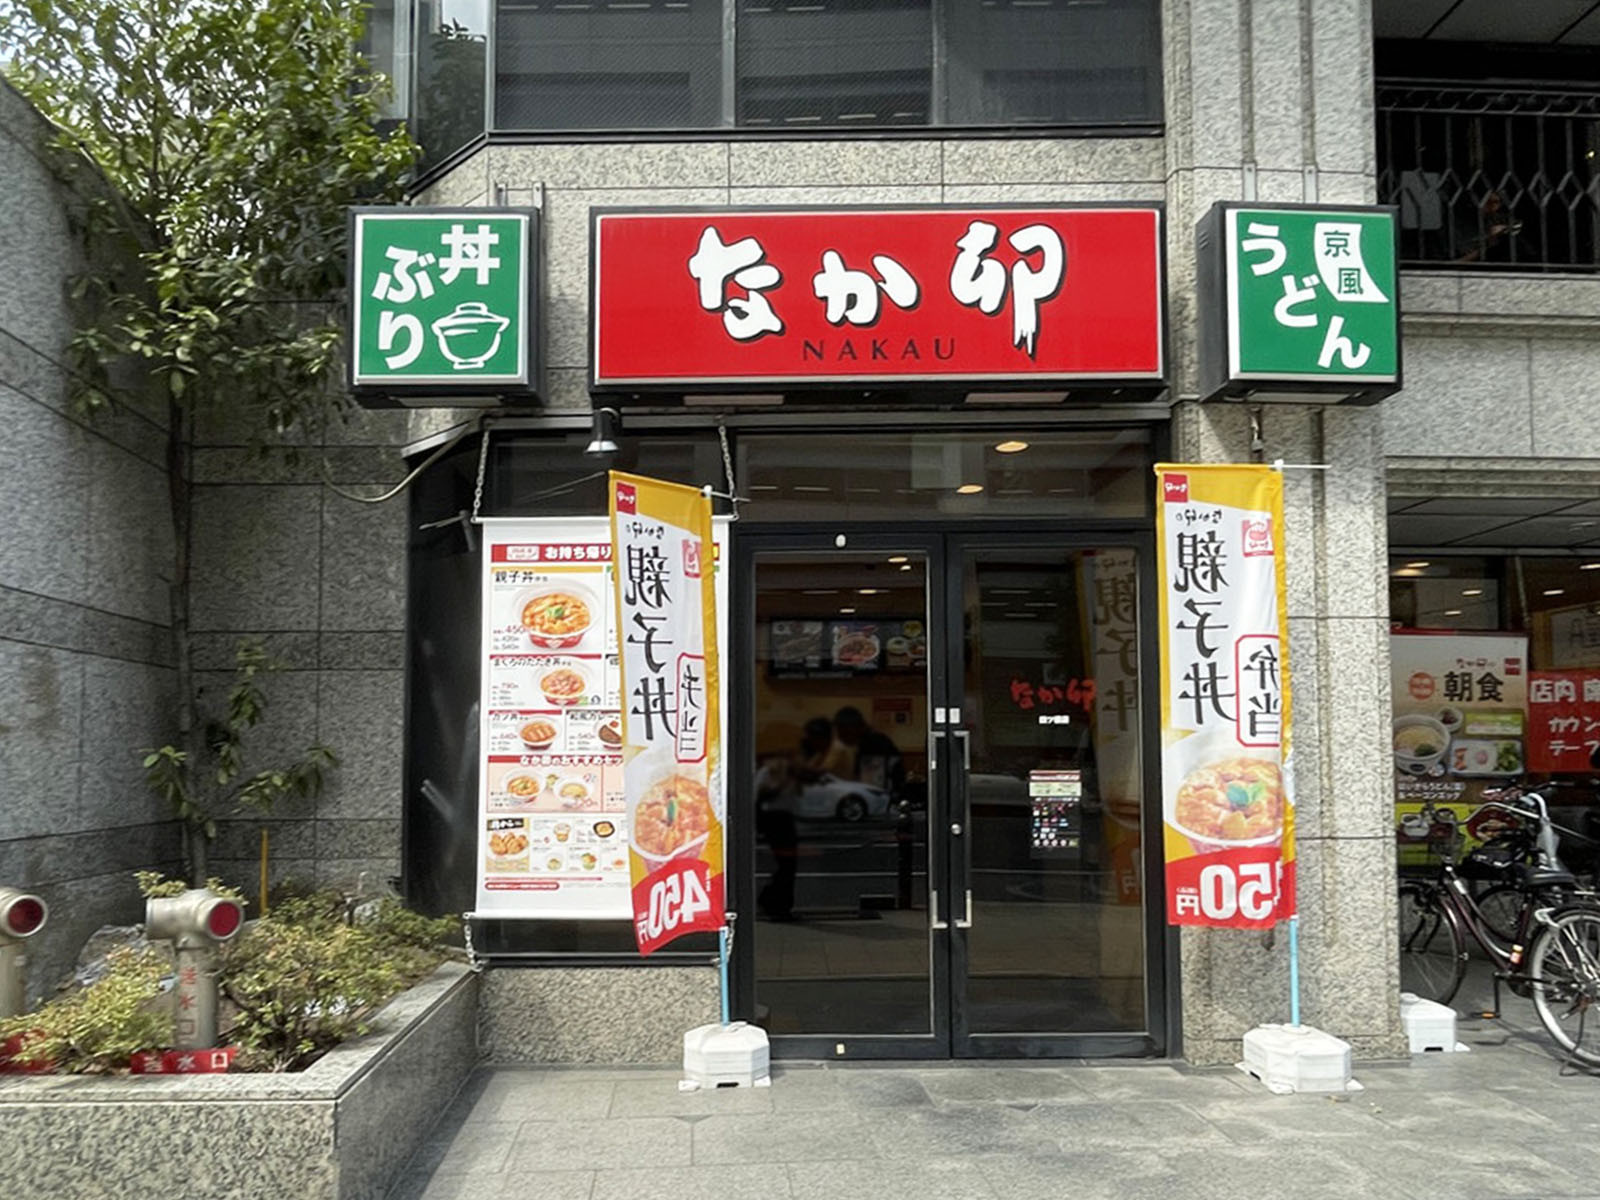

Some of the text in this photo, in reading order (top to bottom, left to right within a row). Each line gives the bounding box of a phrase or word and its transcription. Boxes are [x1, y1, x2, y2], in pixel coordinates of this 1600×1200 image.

[686, 220, 1067, 362] なか卯
[1322, 230, 1364, 295] 京風
[1241, 222, 1371, 369] うどん
[803, 338, 956, 361] NAKAU
[1443, 671, 1504, 702] 朝食
